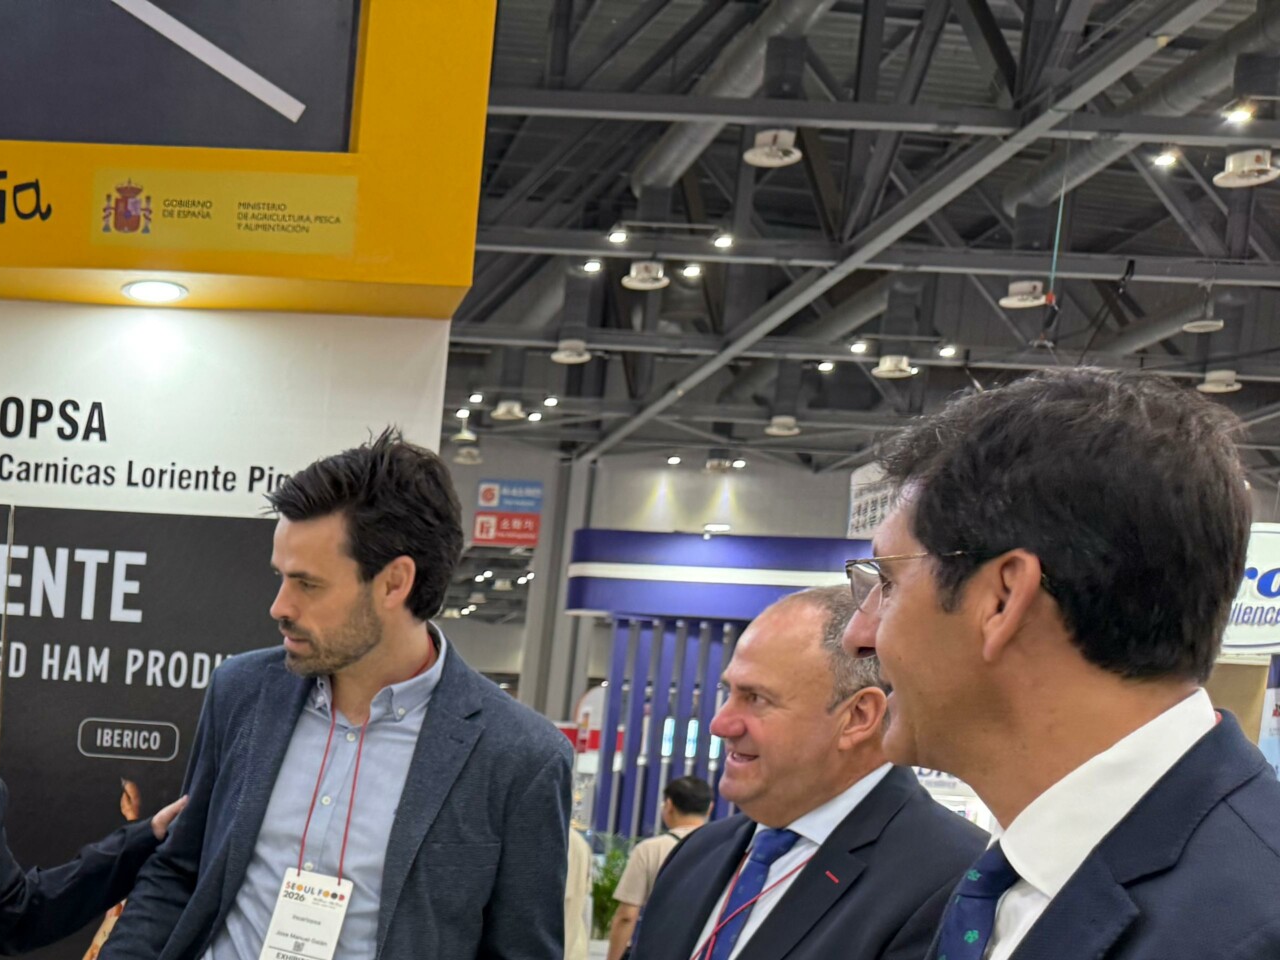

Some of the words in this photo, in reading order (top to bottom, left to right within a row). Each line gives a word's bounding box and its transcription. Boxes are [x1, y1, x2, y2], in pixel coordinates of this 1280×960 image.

[163, 198, 213, 210] GOBIERNO
[237, 201, 287, 212] MINISTERIO
[162, 210, 174, 219] DE
[237, 211, 249, 221] DE
[127, 459, 237, 492] Loriente
[41, 643, 110, 684] HAM
[95, 727, 162, 751] IBERICO
[283, 890, 306, 902] 2026
[285, 881, 315, 895] SEOUL
[317, 888, 346, 902] FOOD
